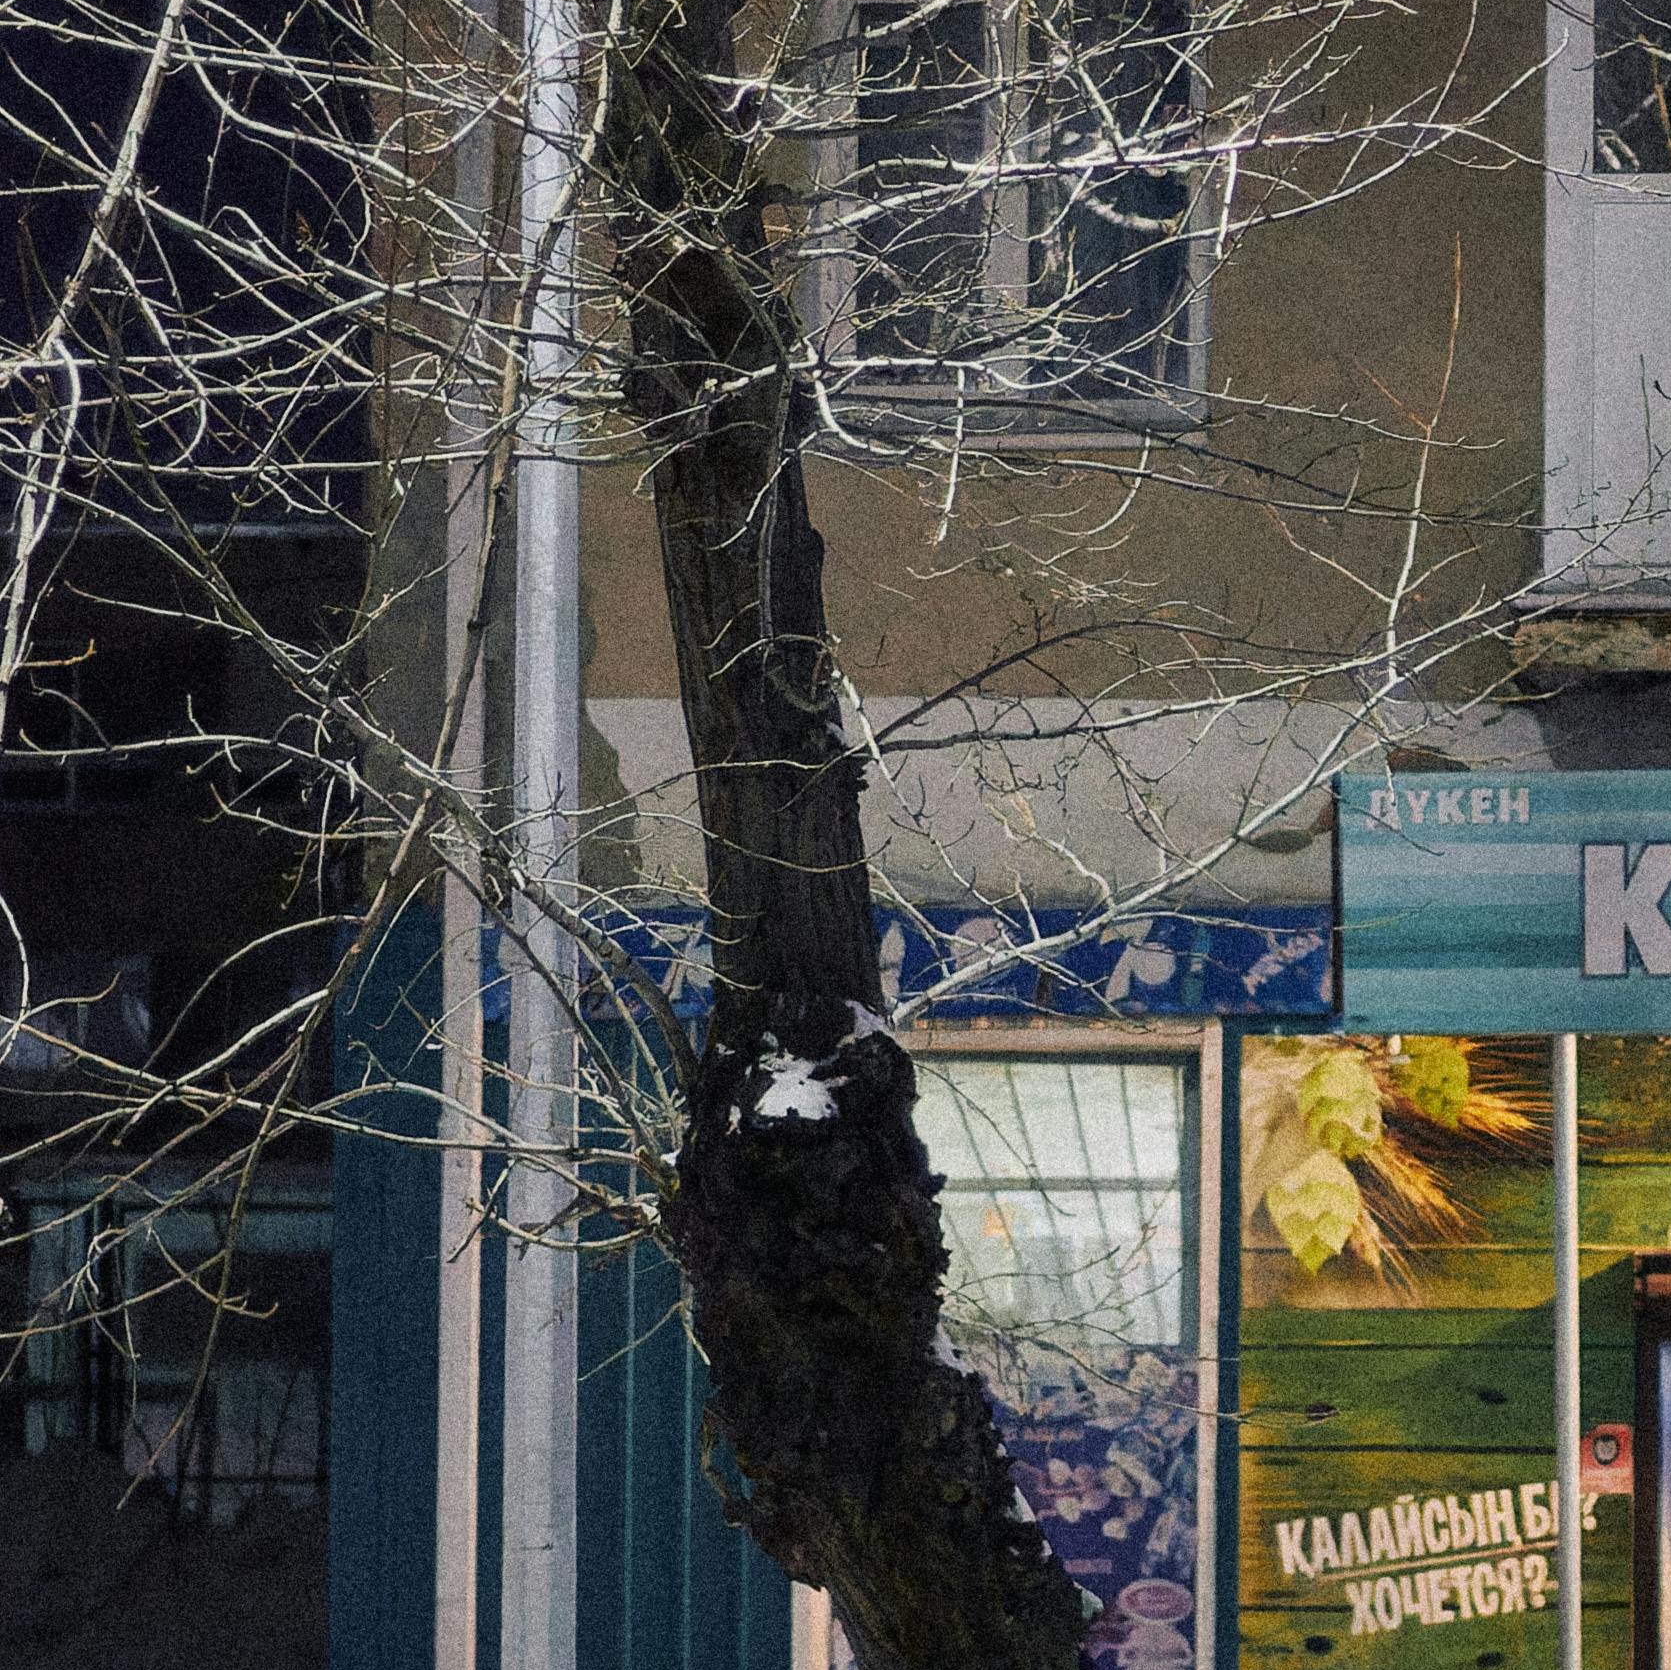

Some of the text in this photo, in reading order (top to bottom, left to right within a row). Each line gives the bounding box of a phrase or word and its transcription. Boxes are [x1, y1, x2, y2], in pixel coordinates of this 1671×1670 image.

[1275, 1479, 1598, 1579] ҚАЛАЙСЫҢ Б?
[1346, 1553, 1550, 1636] ХОЧЕТСЯ?
